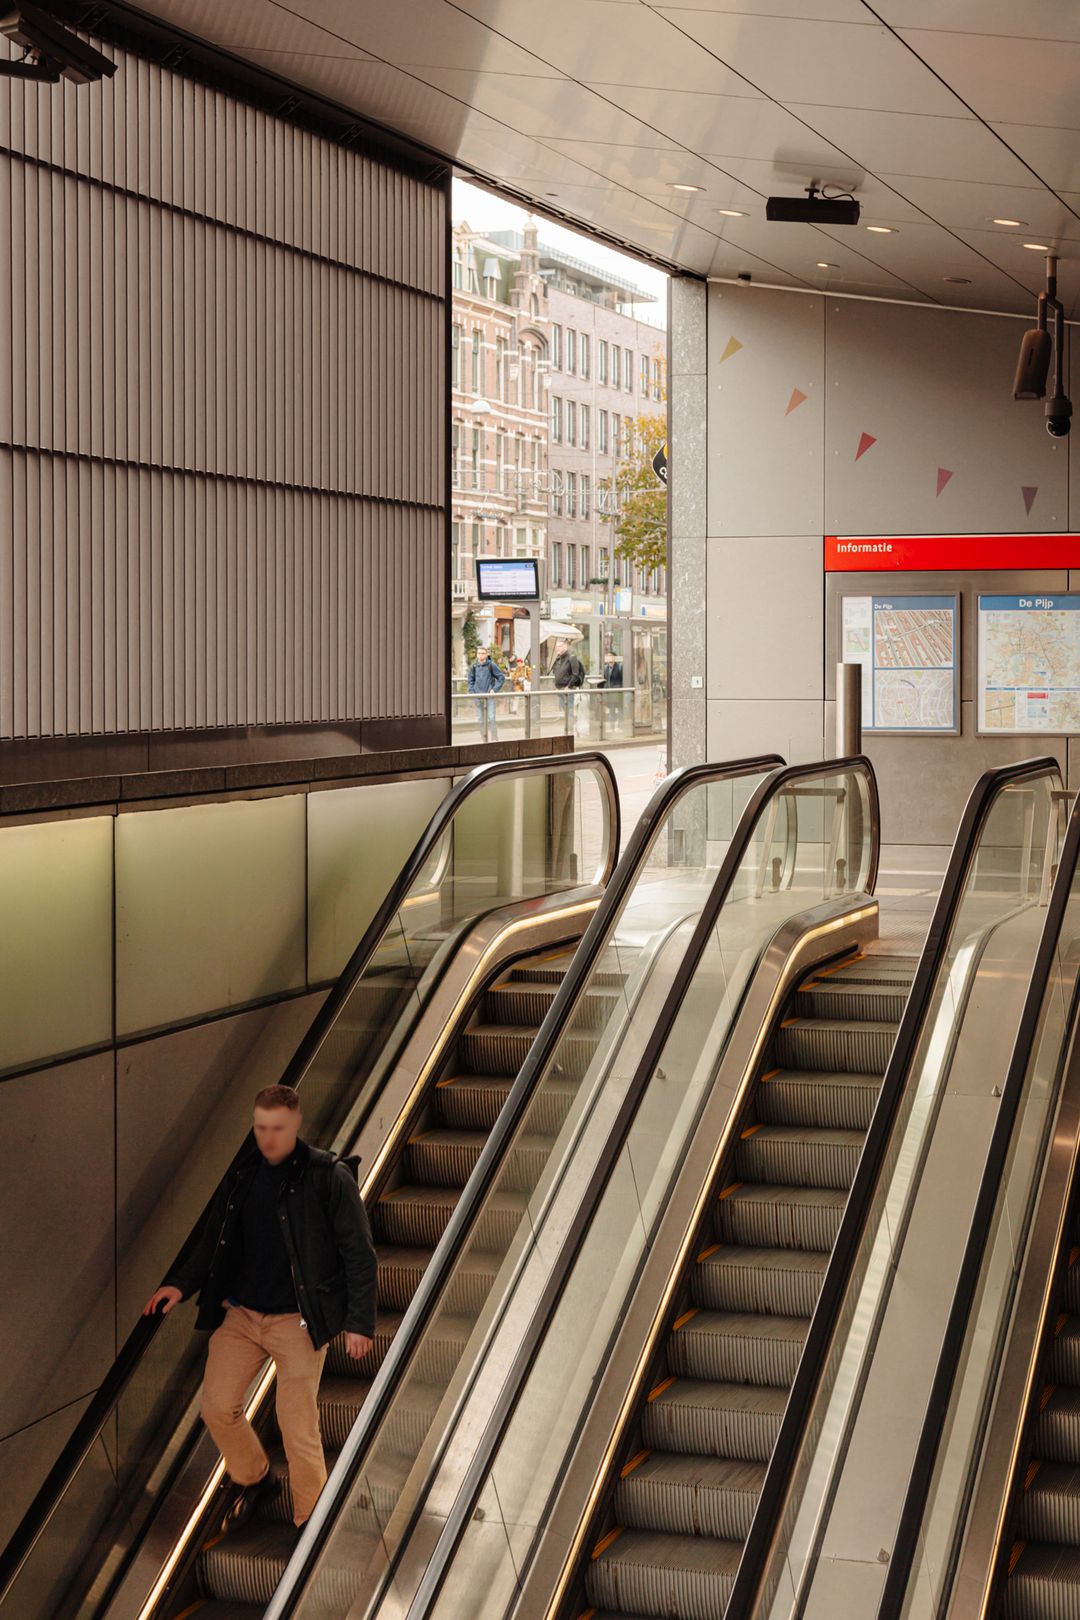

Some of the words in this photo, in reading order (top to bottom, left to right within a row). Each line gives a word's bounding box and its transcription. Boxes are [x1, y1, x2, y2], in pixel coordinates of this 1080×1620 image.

[837, 542, 893, 553] Informatie
[1019, 599, 1033, 608] De
[1035, 598, 1054, 609] Pijp
